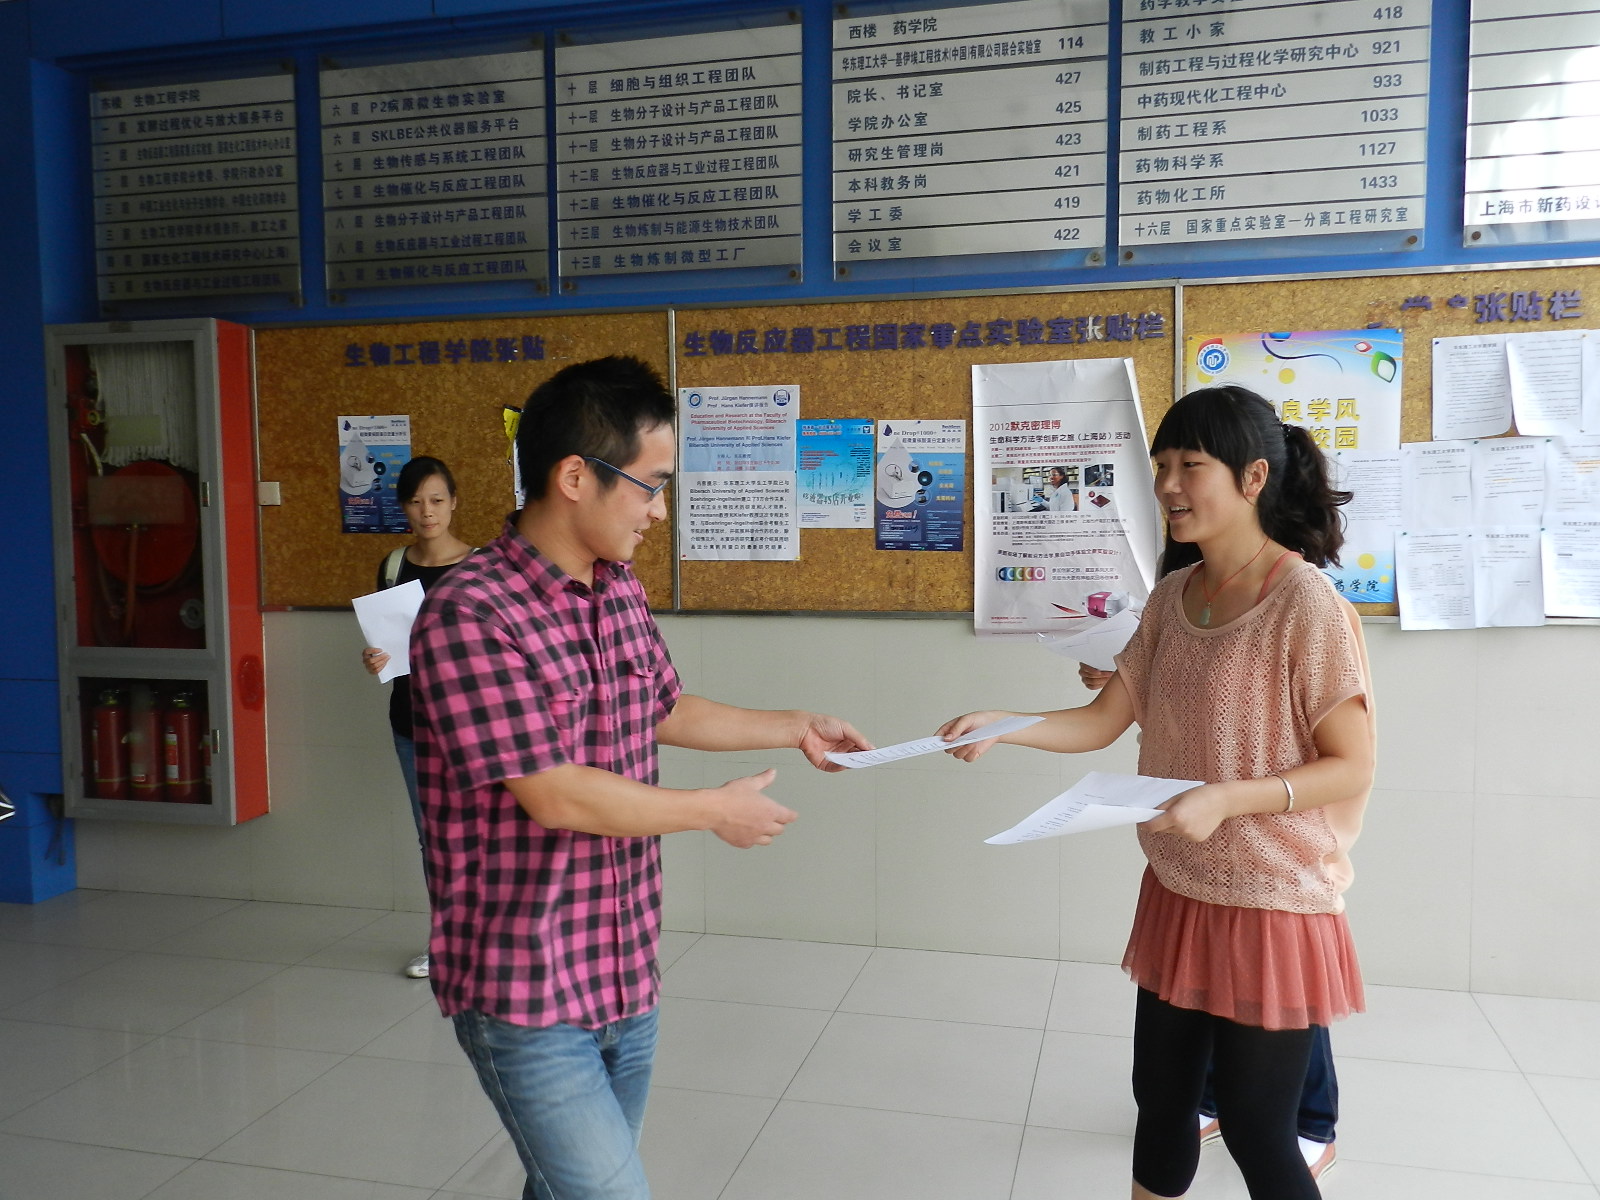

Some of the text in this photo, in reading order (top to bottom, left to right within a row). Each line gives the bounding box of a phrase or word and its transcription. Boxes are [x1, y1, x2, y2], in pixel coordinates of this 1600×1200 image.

[848, 17, 938, 39] 西楼 药学院
[1139, 6, 1403, 44] 教工小家 418
[1058, 36, 1085, 50] 114
[1139, 40, 1402, 77] 制药工程与过程化学研究中心 921
[567, 66, 756, 96] 十层 细胞与组织工程团队
[847, 71, 1081, 104] 院长、书记室 427
[1137, 74, 1403, 109] 中药现代化工程中心 933
[134, 89, 200, 107] 生物工程学院
[331, 89, 506, 117] 六层 P2病原微生物实验室
[568, 94, 779, 125] 十一层 生物分子设计与产品工程团队
[848, 100, 1082, 132] 学院办公室 425
[1137, 107, 1399, 141] 制药工程系 1033
[333, 117, 520, 146] 六层 SKLBE公共仪器服务平台
[569, 125, 779, 154] 十一层 生物分子设计与产品工程团队
[333, 145, 526, 173] 七层 生物传感与系统工程团队
[848, 132, 1082, 163] 研究生管理岗 423
[1135, 141, 1397, 174] 药物科学系 1127
[569, 155, 780, 184] 十二层 生物反应器与工业过程工程团队
[848, 164, 1080, 193] 本科教务岗 421
[334, 174, 526, 200] 七层 生物催化与反应工程团队
[570, 185, 779, 213] 十二层 生物催化与反应工程团队
[1136, 175, 1398, 206] 药物化工所 1433
[374, 205, 527, 228] 生物分子设计与产品工程团队
[847, 196, 1081, 223] 学工委 419
[375, 230, 528, 253] 生物反应器与工业过程工程团队
[570, 214, 780, 241] 十三层 生物炼制与能源生物技术团队
[847, 227, 1080, 254] 会议室 422
[1134, 220, 1171, 237] 十六层
[376, 259, 528, 282] 生物催化与反应工程团队
[571, 247, 746, 270] 十三层 生物炼制微型工厂
[684, 311, 1164, 357] 生物反应器工程国家重点实验室张贴栏
[1268, 397, 1360, 422] 良学风
[989, 420, 1061, 432] 2012默克密理博
